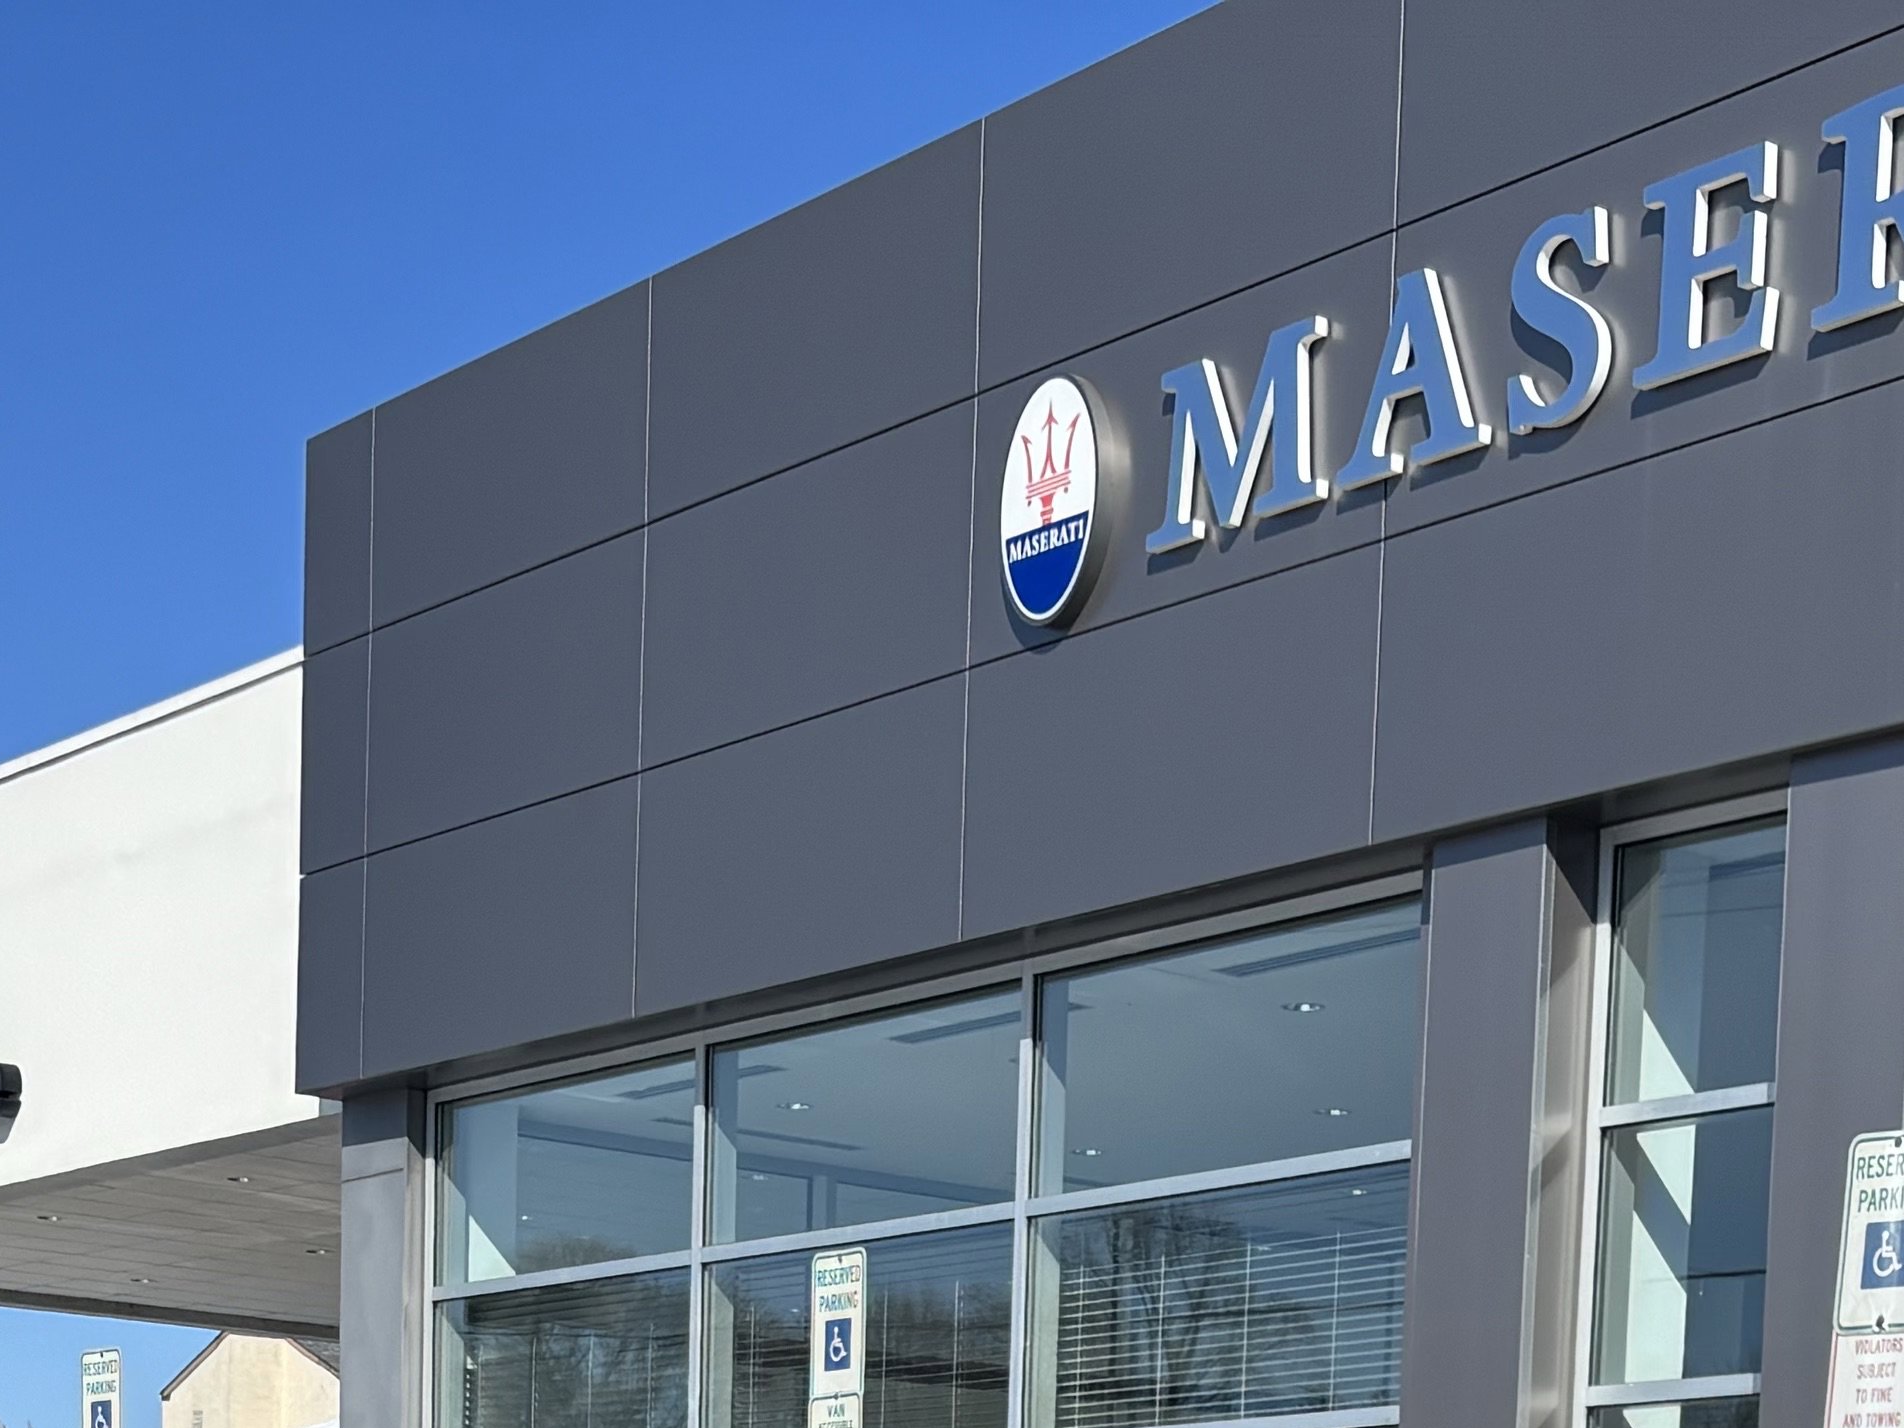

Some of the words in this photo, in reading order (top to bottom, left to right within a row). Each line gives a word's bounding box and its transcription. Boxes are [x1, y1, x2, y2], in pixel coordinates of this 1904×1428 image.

[1009, 518, 1084, 563] MASERATI
[817, 1265, 860, 1287] RESERVED
[819, 1290, 858, 1312] PARKING
[1855, 1338, 1903, 1355] VIOLATORS
[1856, 1362, 1897, 1379] SUBJECT
[1856, 1388, 1867, 1404] TO
[1871, 1388, 1893, 1403] FINE
[827, 1403, 845, 1418] VAN
[1842, 1413, 1862, 1428] AND
[1866, 1412, 1901, 1428] TOWING
